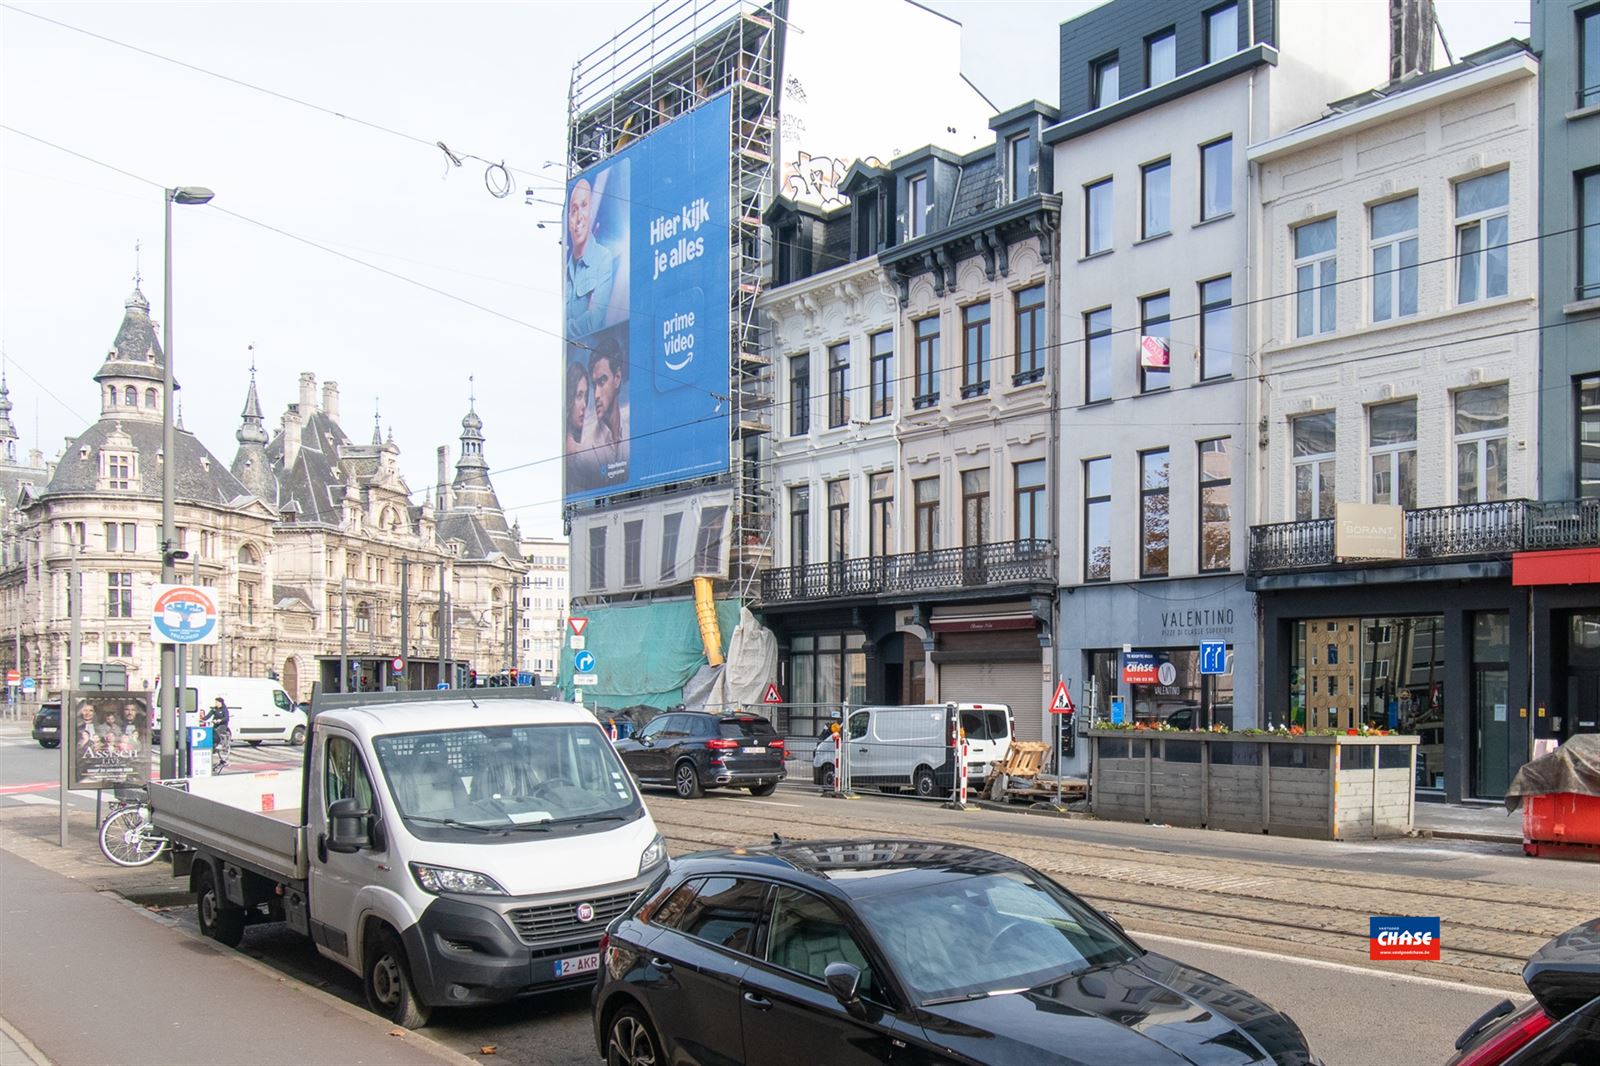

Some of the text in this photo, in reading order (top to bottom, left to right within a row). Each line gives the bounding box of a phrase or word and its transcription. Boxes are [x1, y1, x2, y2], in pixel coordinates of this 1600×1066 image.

[650, 197, 710, 246] Hier kijk
[653, 236, 705, 281] je alles
[663, 311, 695, 340] prime
[664, 333, 695, 356] video
[1161, 608, 1234, 628] VALENTINO
[1184, 628, 1204, 636] CLASSE
[1126, 663, 1154, 673] CHASE
[1154, 686, 1180, 695] VALENTINO
[192, 728, 207, 747] P
[82, 746, 138, 759] Assisen
